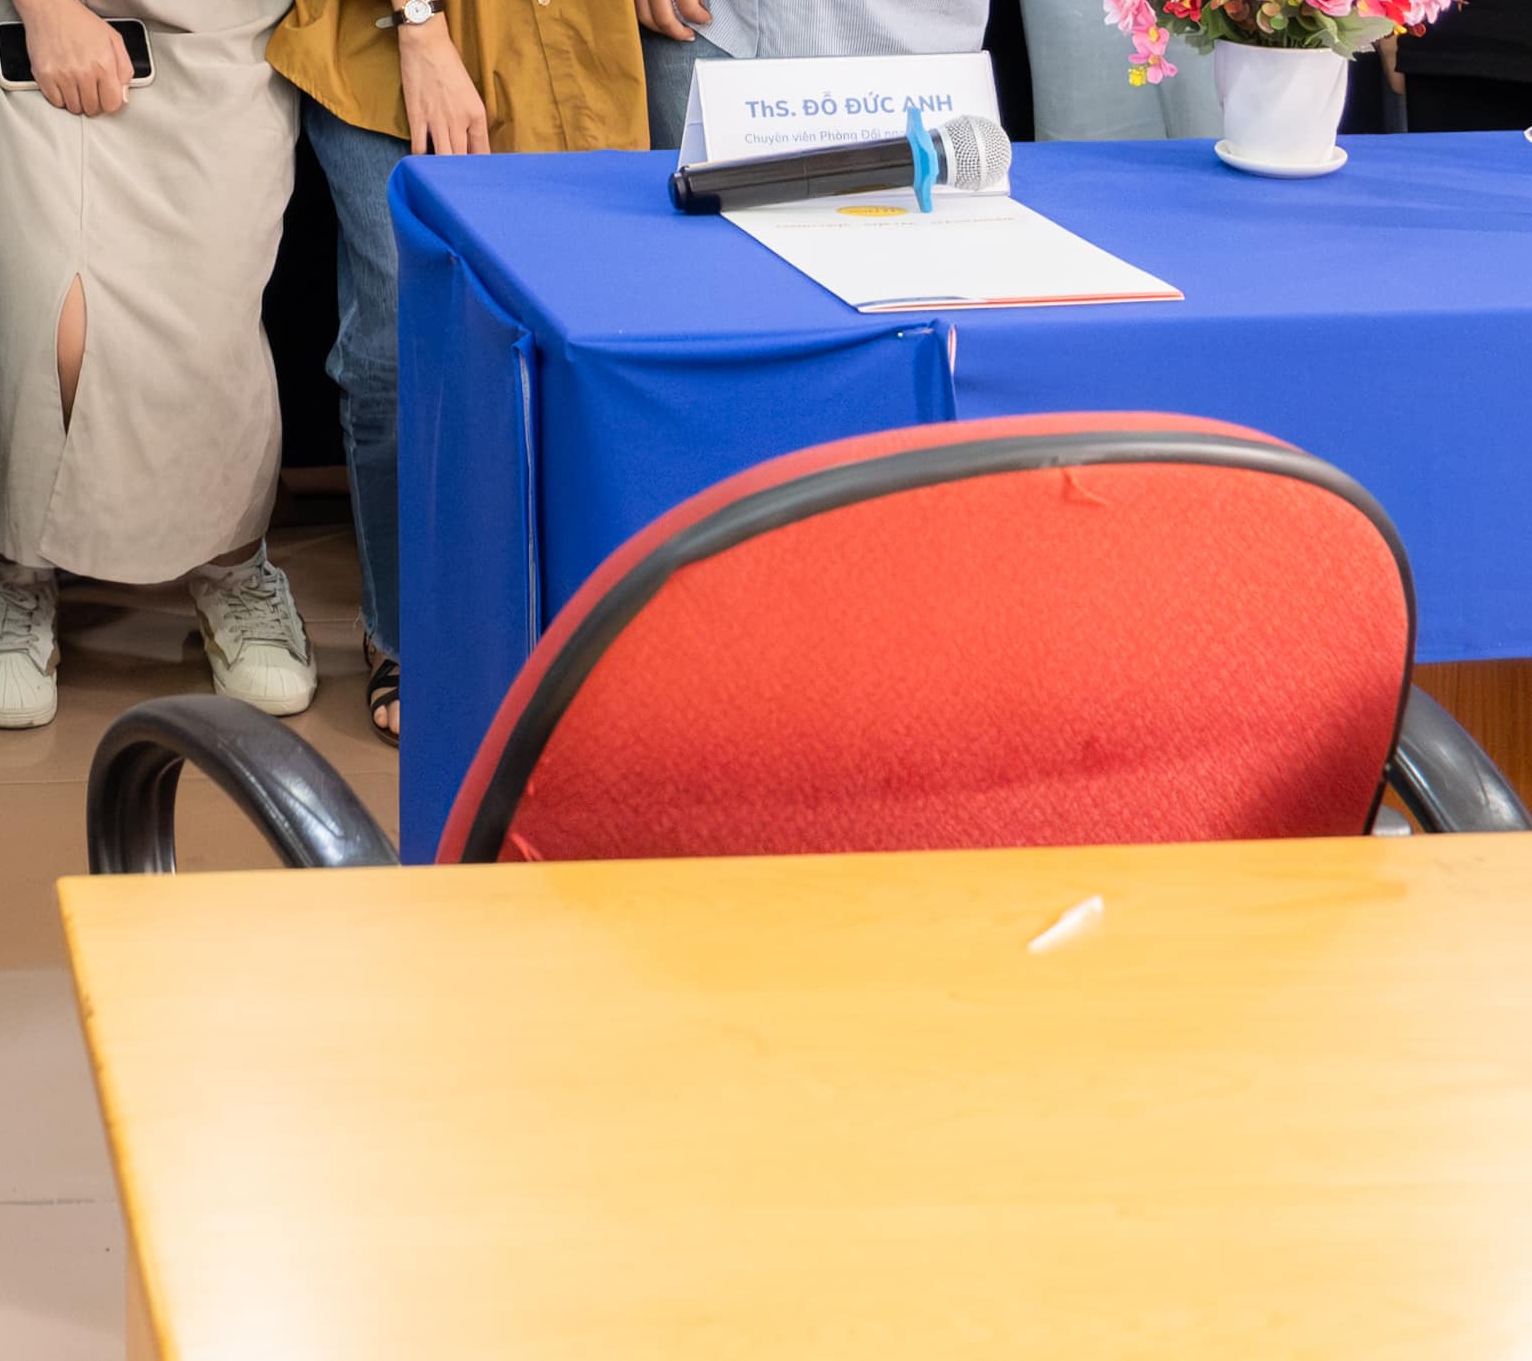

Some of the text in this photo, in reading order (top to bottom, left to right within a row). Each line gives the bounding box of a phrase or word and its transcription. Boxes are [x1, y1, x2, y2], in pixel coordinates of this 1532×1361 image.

[745, 100, 796, 118] ThS.
[802, 90, 837, 116] ĐỖ
[845, 91, 895, 114] ĐỨC
[745, 133, 789, 145] Chuyên
[793, 131, 816, 143] viên
